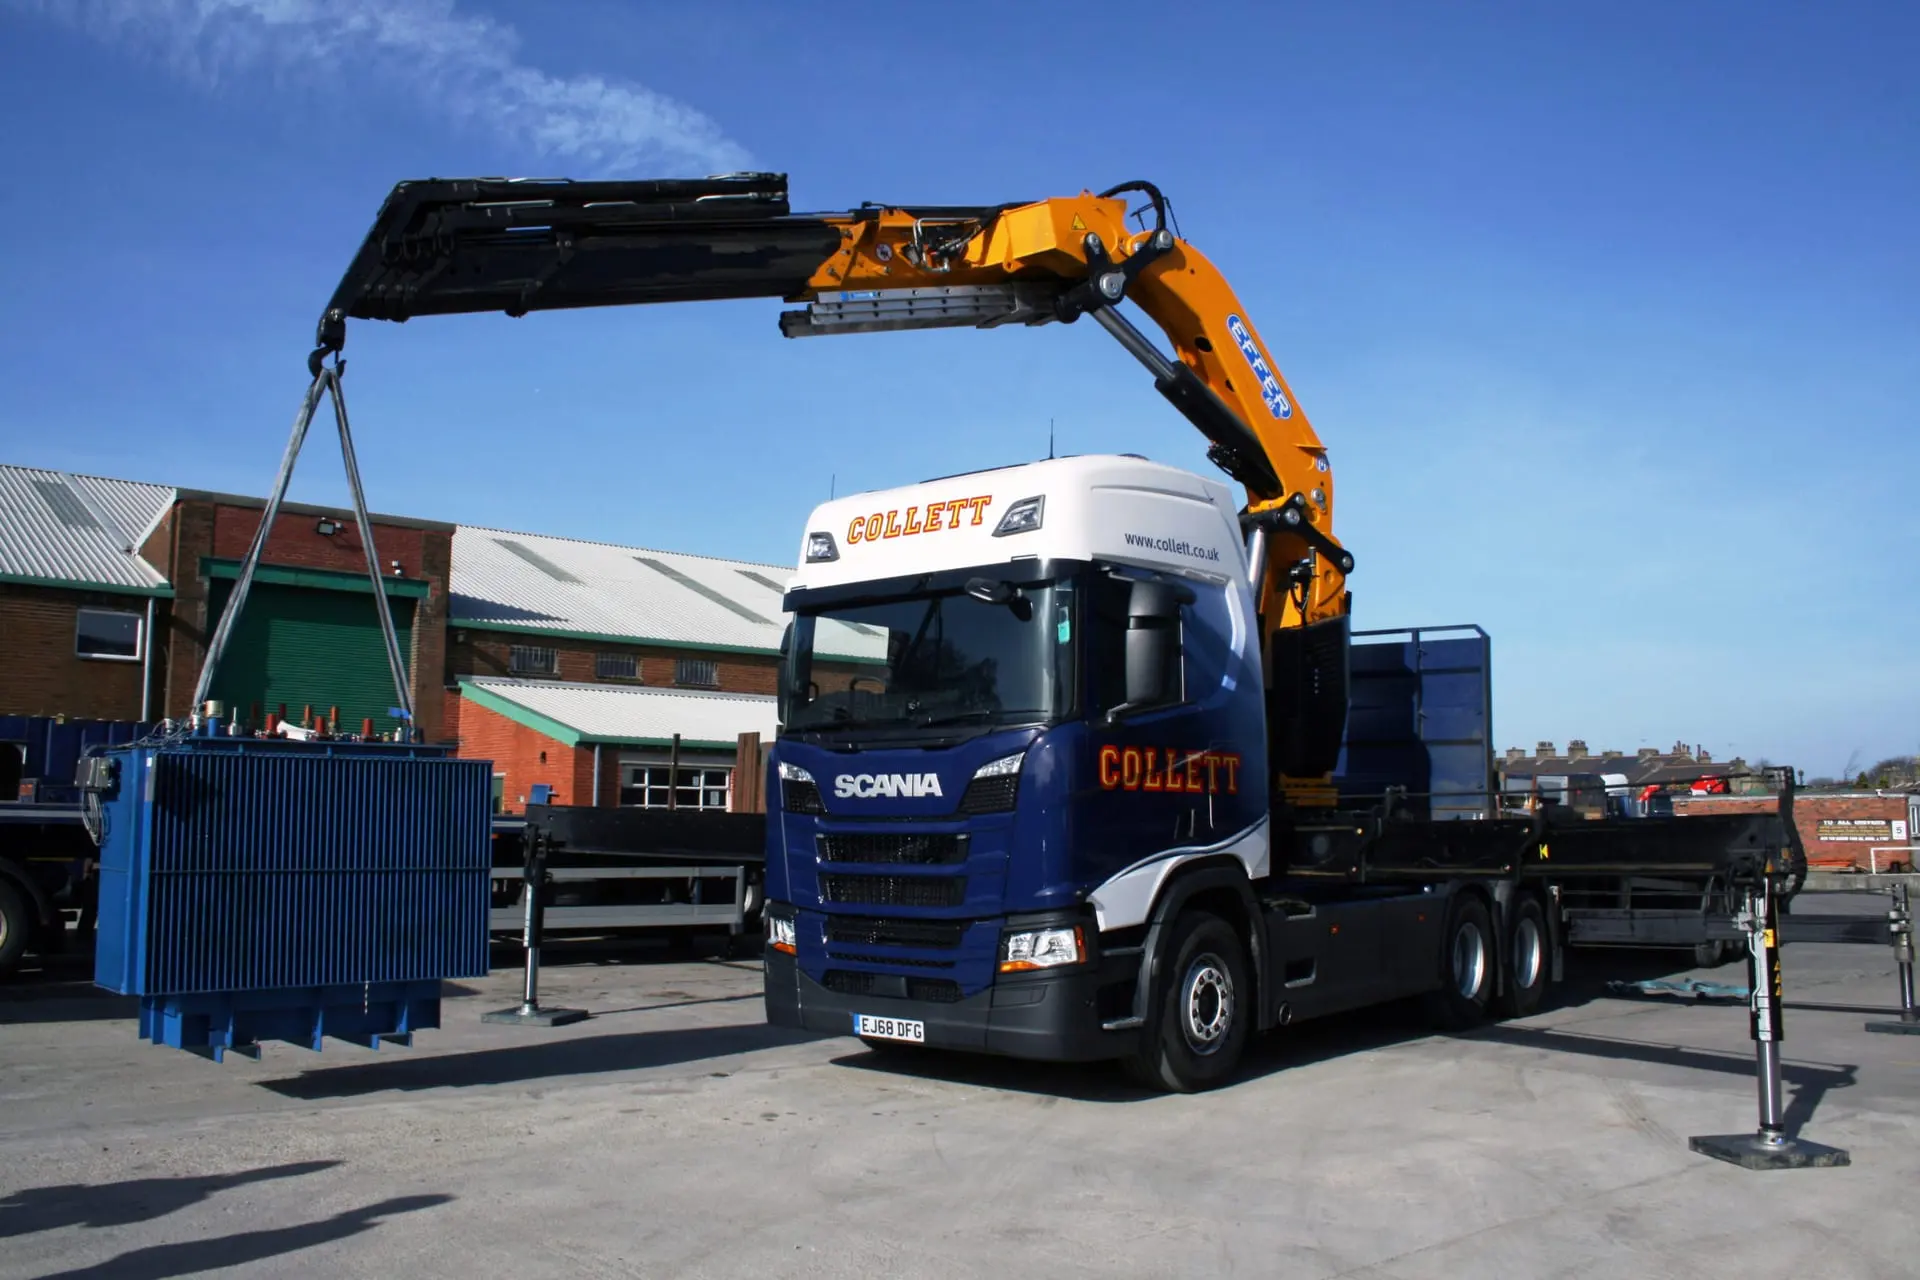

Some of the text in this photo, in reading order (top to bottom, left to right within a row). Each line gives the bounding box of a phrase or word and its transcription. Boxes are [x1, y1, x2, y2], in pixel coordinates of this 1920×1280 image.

[1231, 320, 1290, 415] EFFER
[847, 495, 992, 544] COLLETT
[1124, 533, 1220, 561] www.collett.co.uk
[834, 773, 943, 798] SCANIA
[1099, 744, 1241, 793] COLLETT
[862, 1017, 922, 1039] EJ68 DFG
